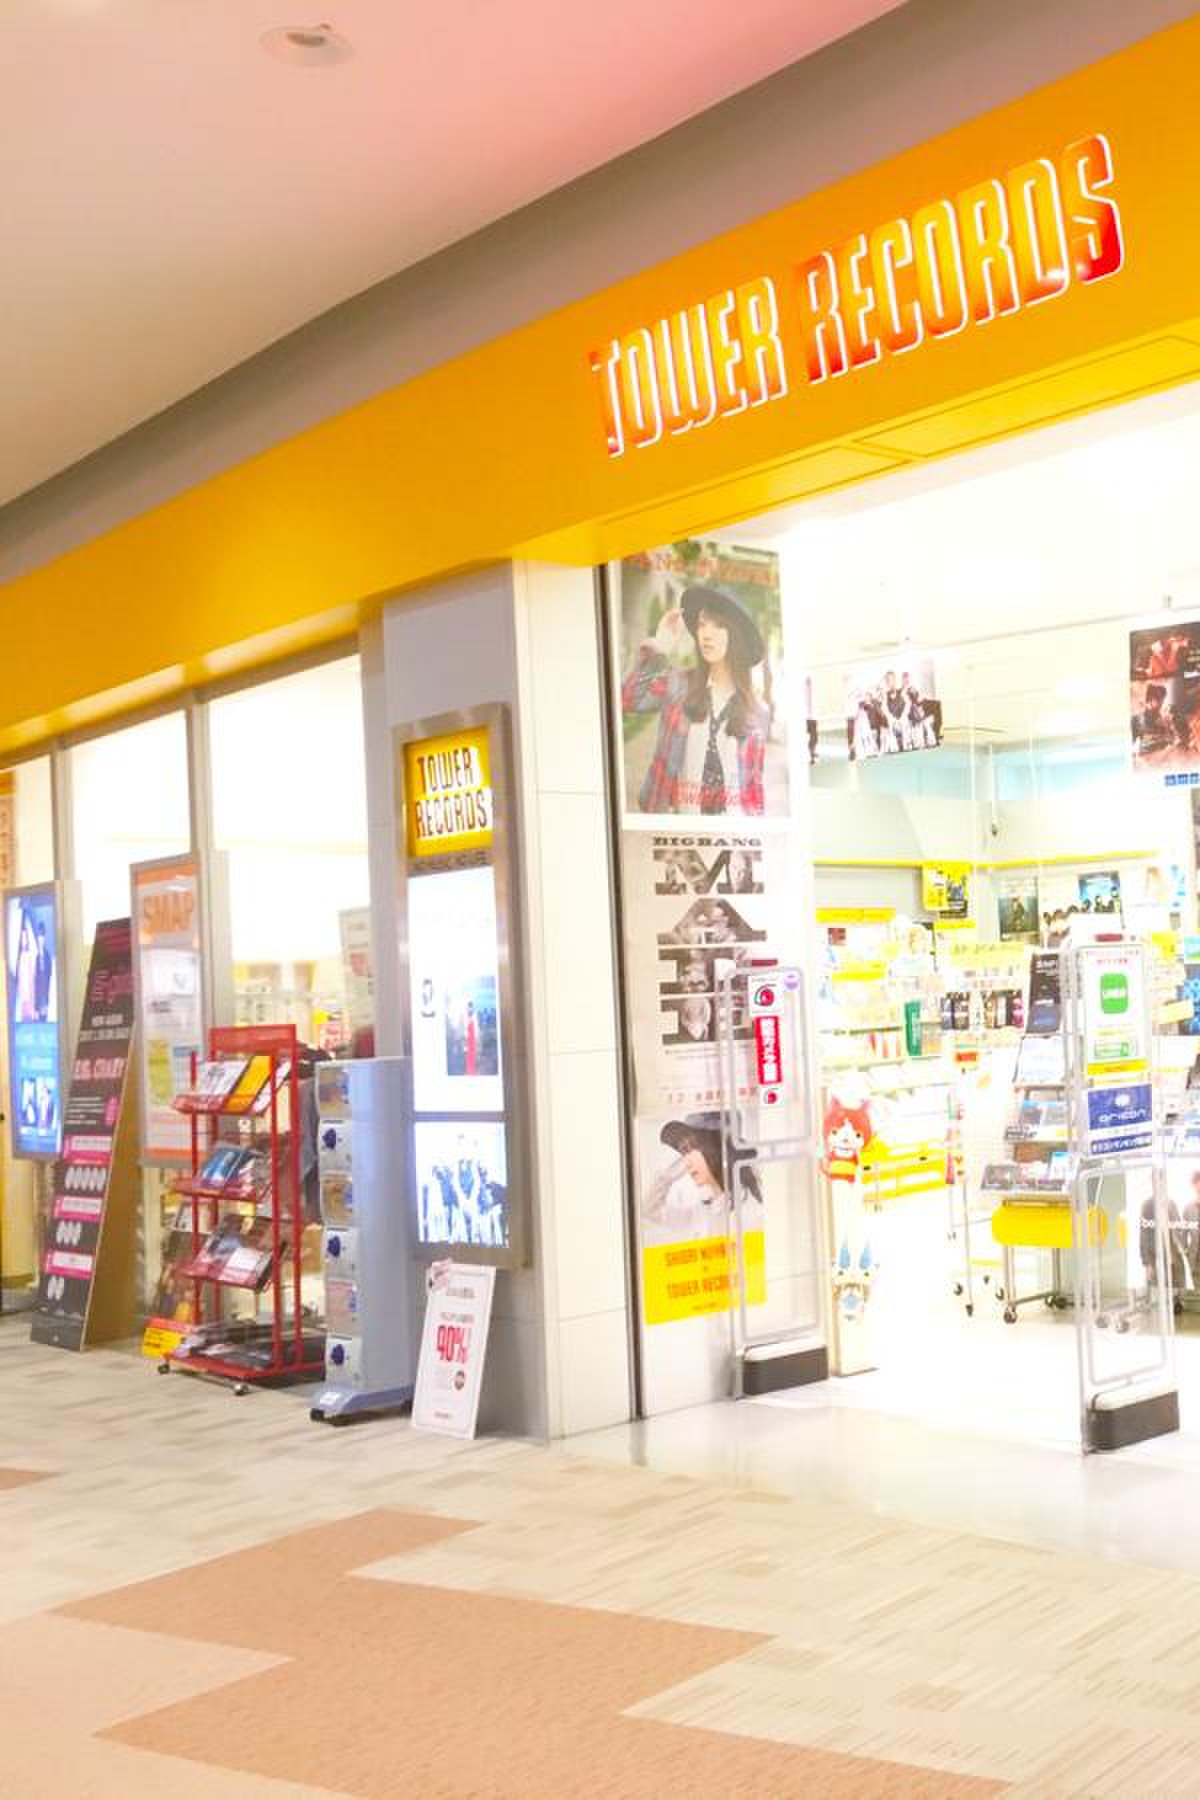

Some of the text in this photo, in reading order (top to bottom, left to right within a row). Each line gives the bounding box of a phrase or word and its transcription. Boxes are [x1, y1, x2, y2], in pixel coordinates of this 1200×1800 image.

[588, 133, 1126, 459] TOWER RECORDS
[416, 746, 474, 795] TOWER
[415, 789, 489, 839] RECORDS
[652, 835, 762, 847] BIGBANG
